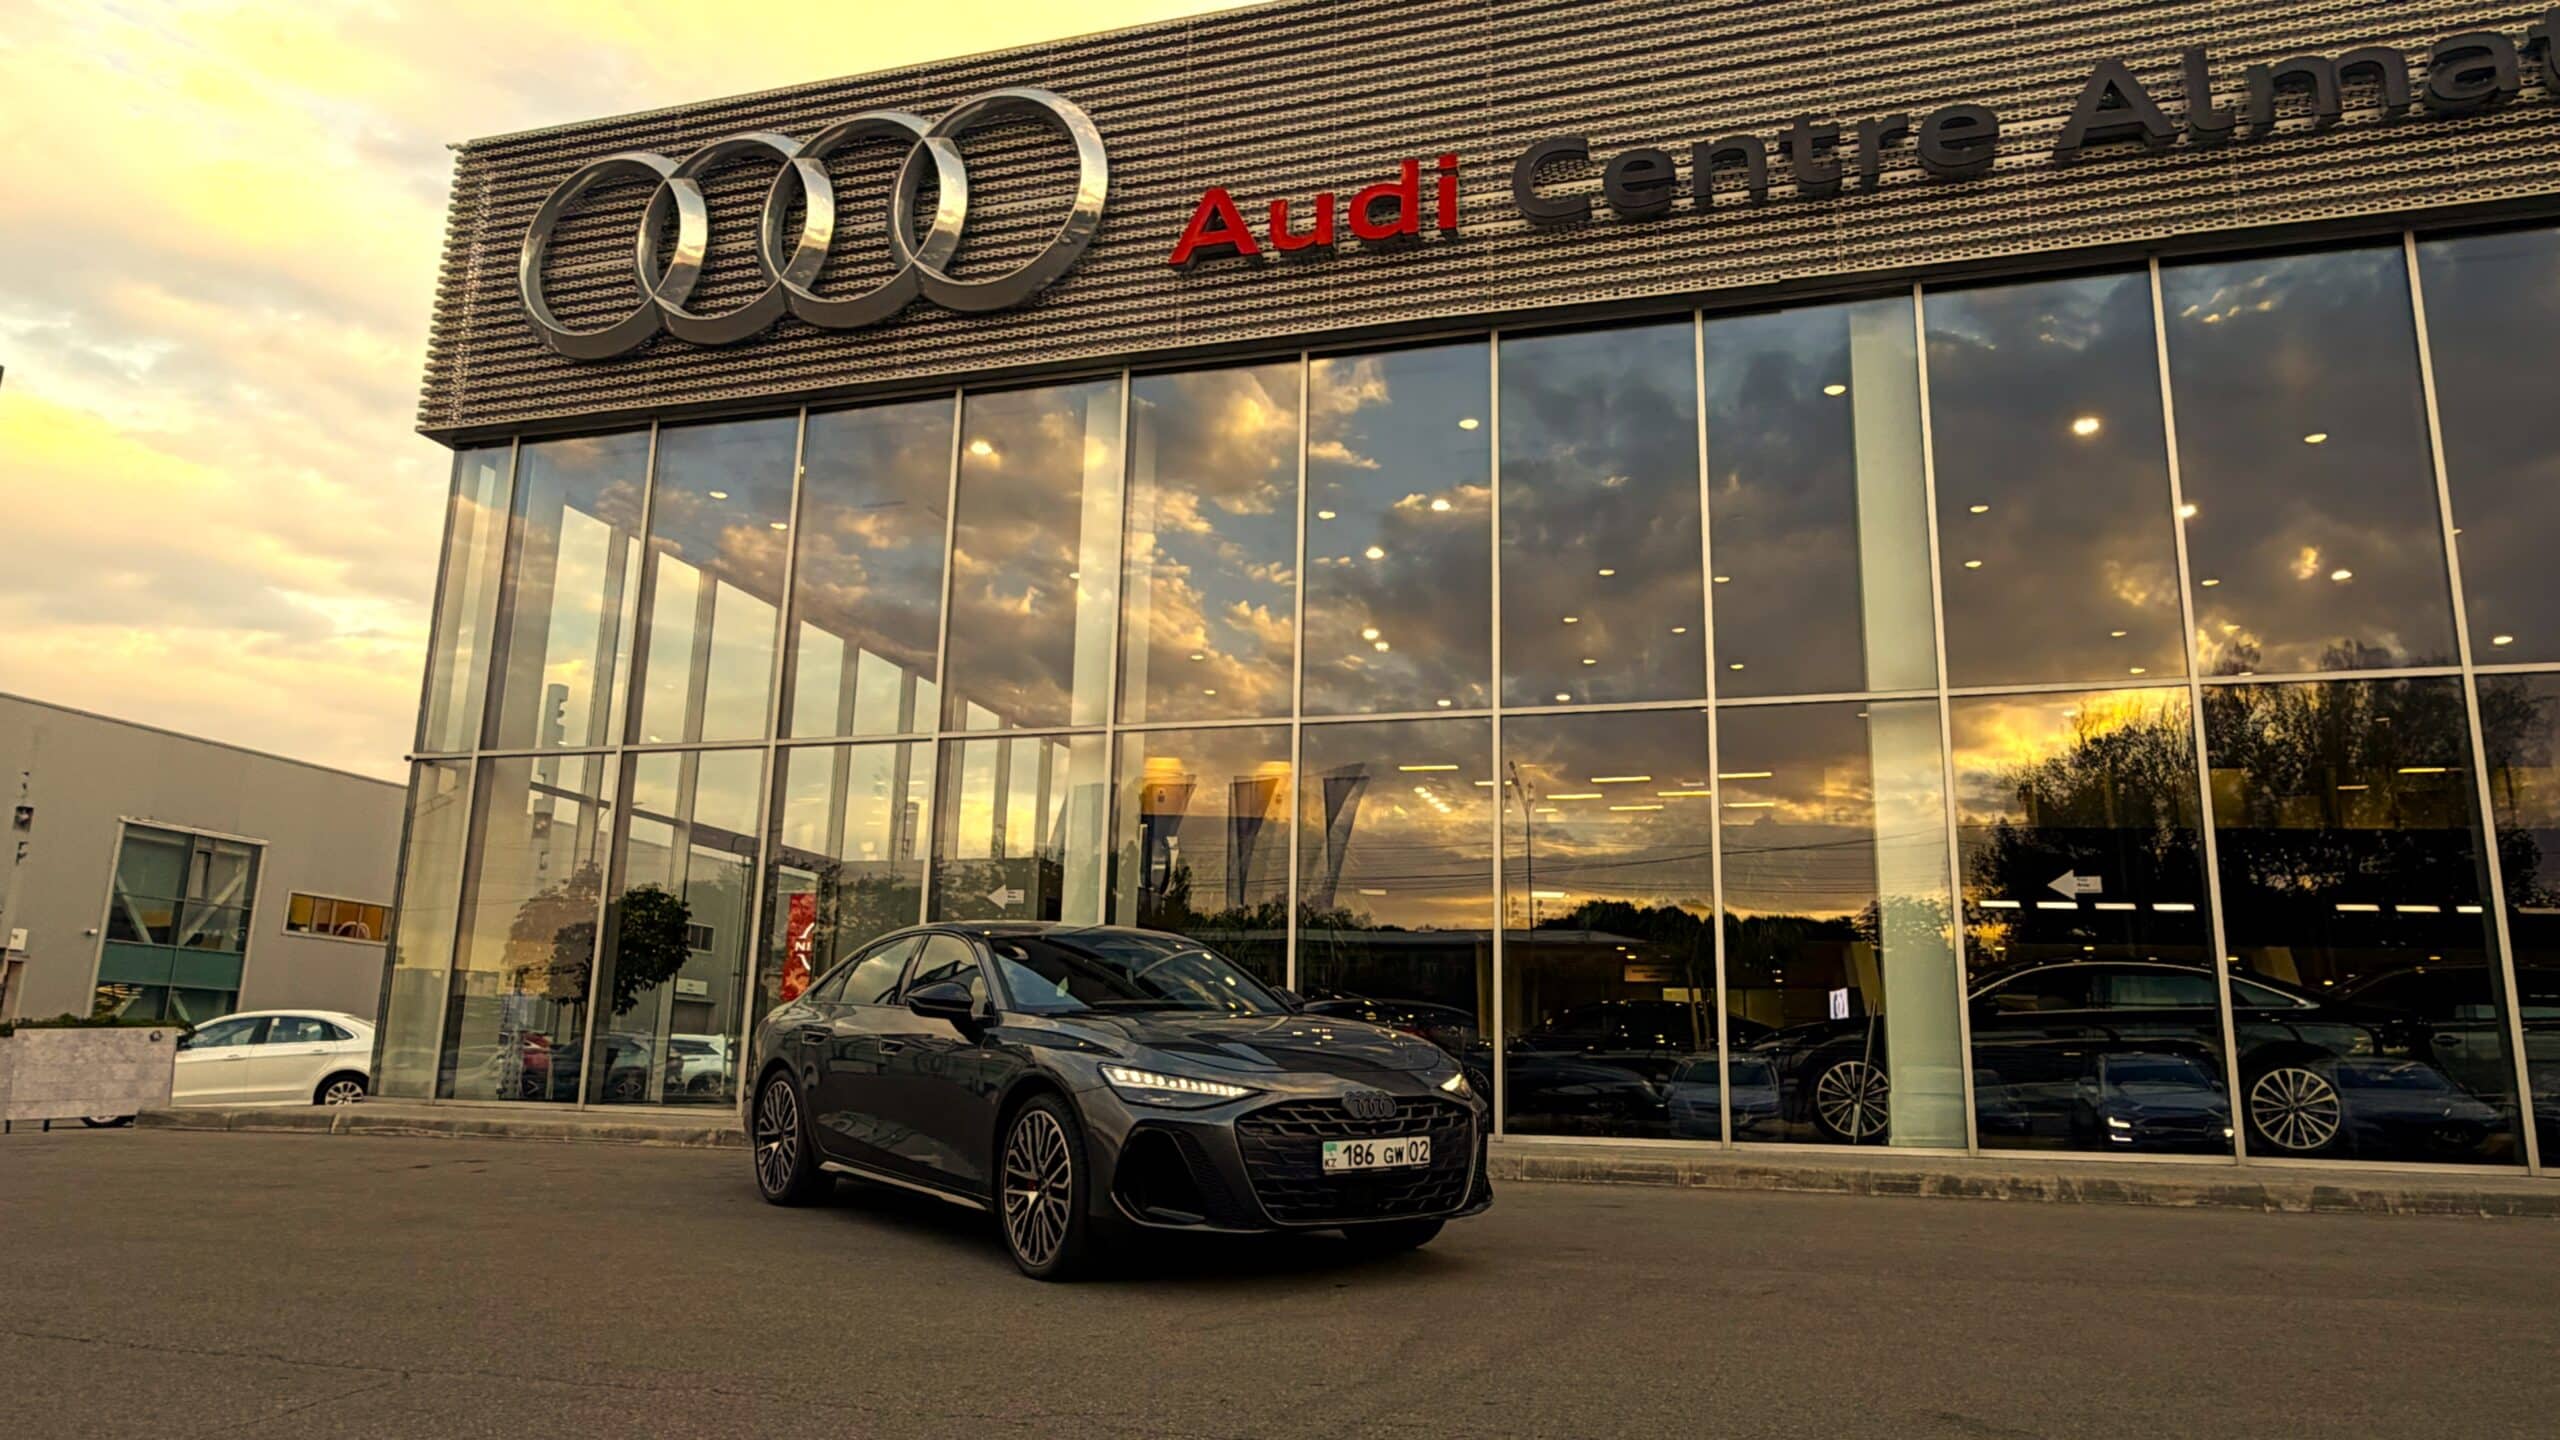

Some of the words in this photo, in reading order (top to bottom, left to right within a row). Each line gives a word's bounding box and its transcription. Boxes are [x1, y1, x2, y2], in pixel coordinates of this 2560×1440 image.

[1168, 153, 1460, 271] Audi
[1512, 104, 1999, 226] Centre
[1324, 1158, 1337, 1168] KZ
[1342, 1143, 1375, 1166] 186
[1383, 1147, 1405, 1164] GW
[1408, 1141, 1429, 1162] 02
